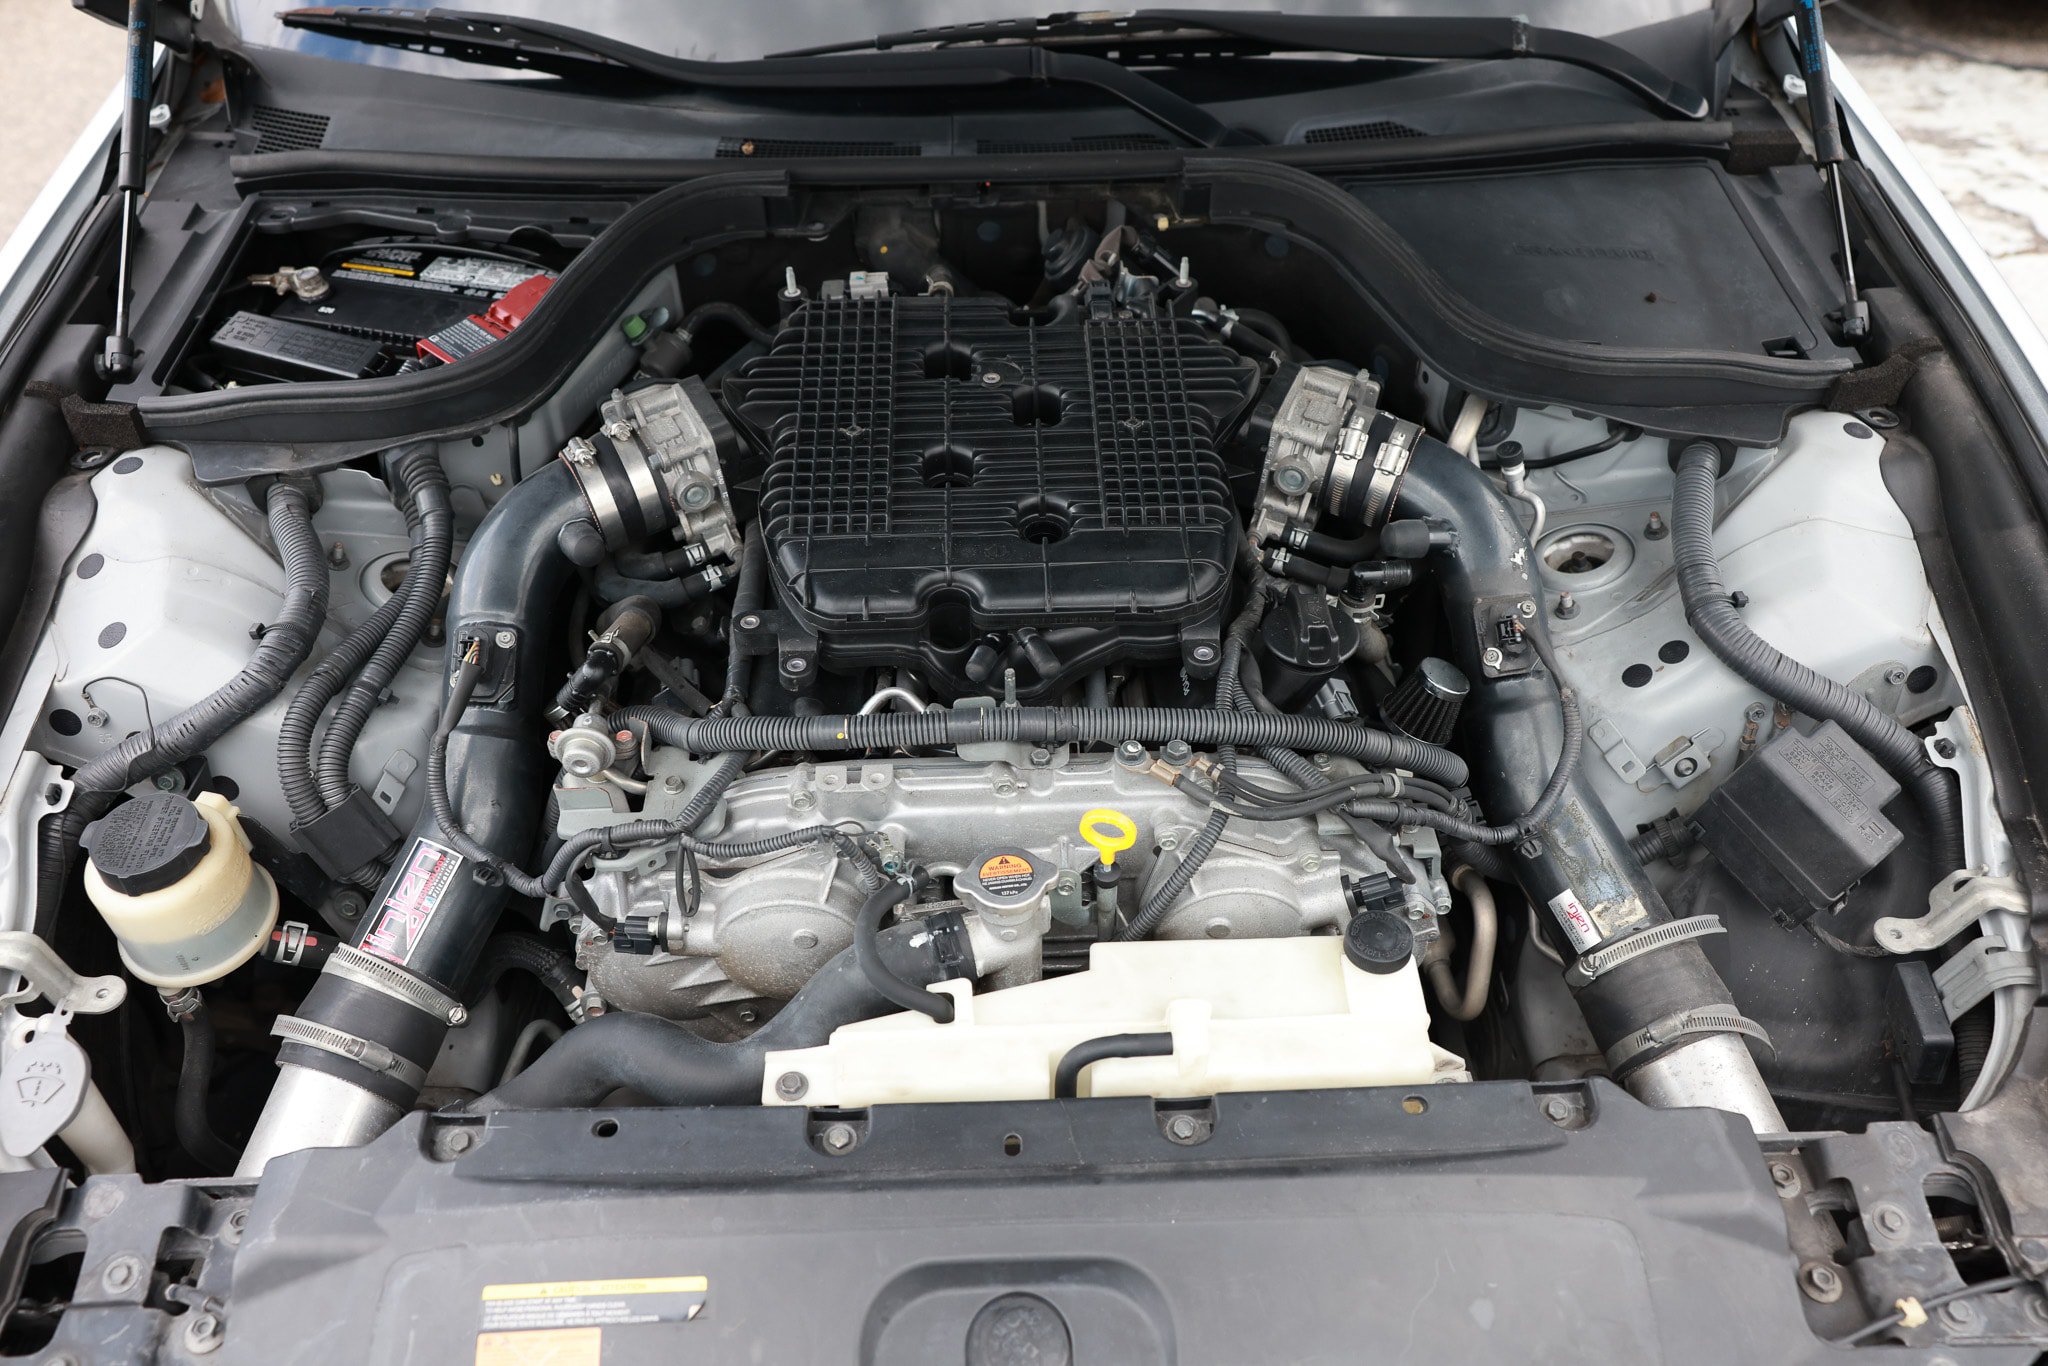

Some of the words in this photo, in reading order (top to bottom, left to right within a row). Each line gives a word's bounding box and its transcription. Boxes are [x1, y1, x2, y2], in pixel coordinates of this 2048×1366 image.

[145, 815, 163, 849] STEERING
[414, 854, 447, 909] TECHNOLOGY
[431, 857, 457, 899] Filtration
[981, 867, 1030, 878] AVERTISSEMENT
[988, 863, 1022, 872] WARNING
[1566, 901, 1590, 933] injen
